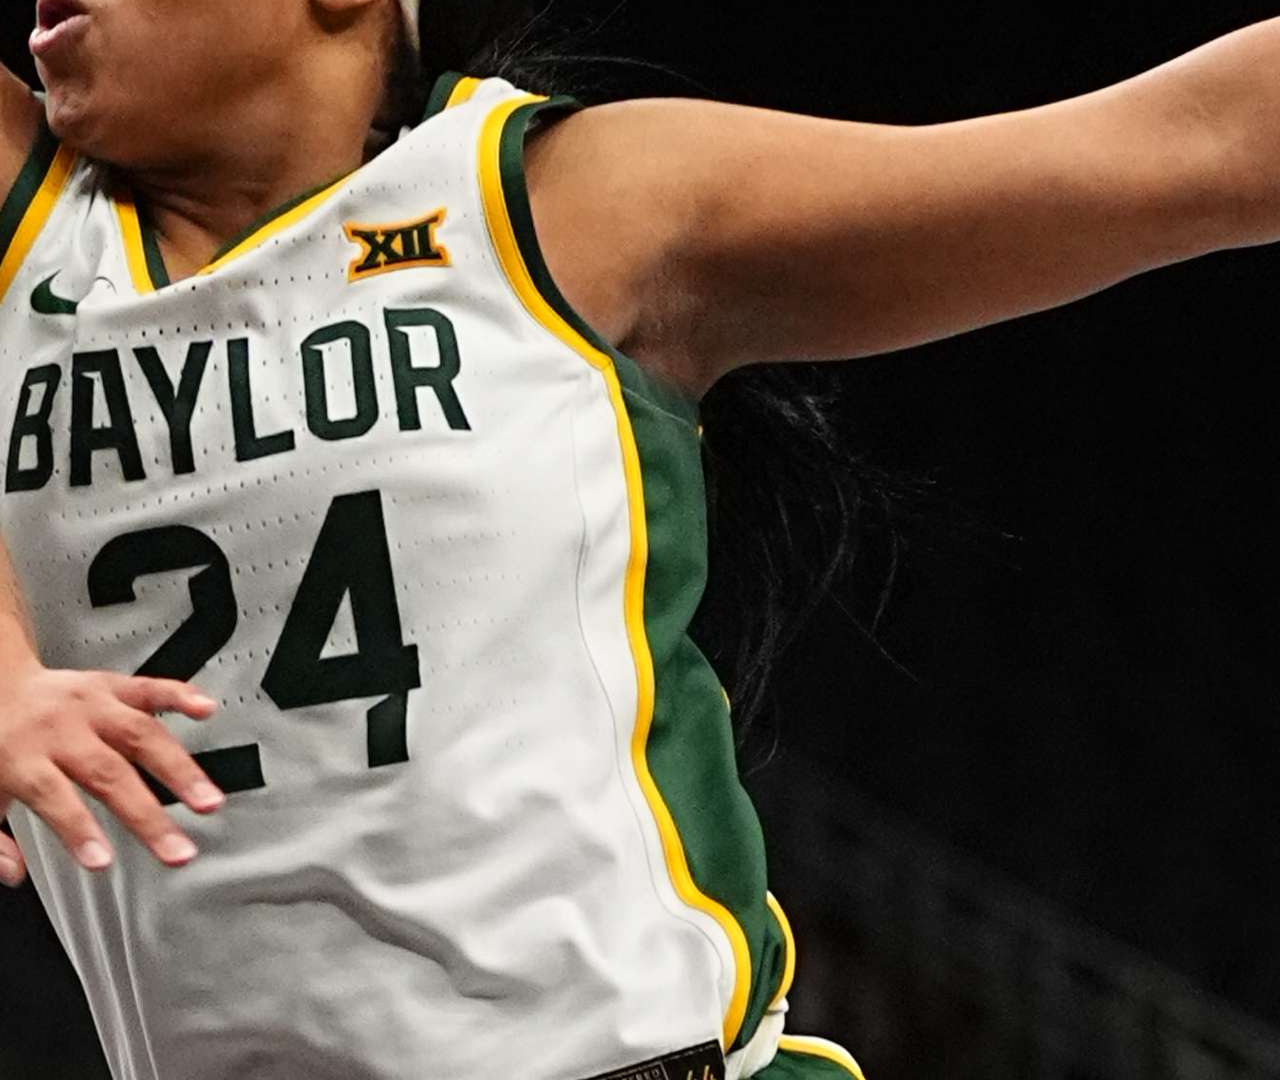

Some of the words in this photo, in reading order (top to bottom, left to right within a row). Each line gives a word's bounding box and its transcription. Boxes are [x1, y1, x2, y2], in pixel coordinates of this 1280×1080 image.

[349, 215, 443, 274] XII
[5, 306, 472, 494] BAYLOR
[87, 488, 421, 806] 24
